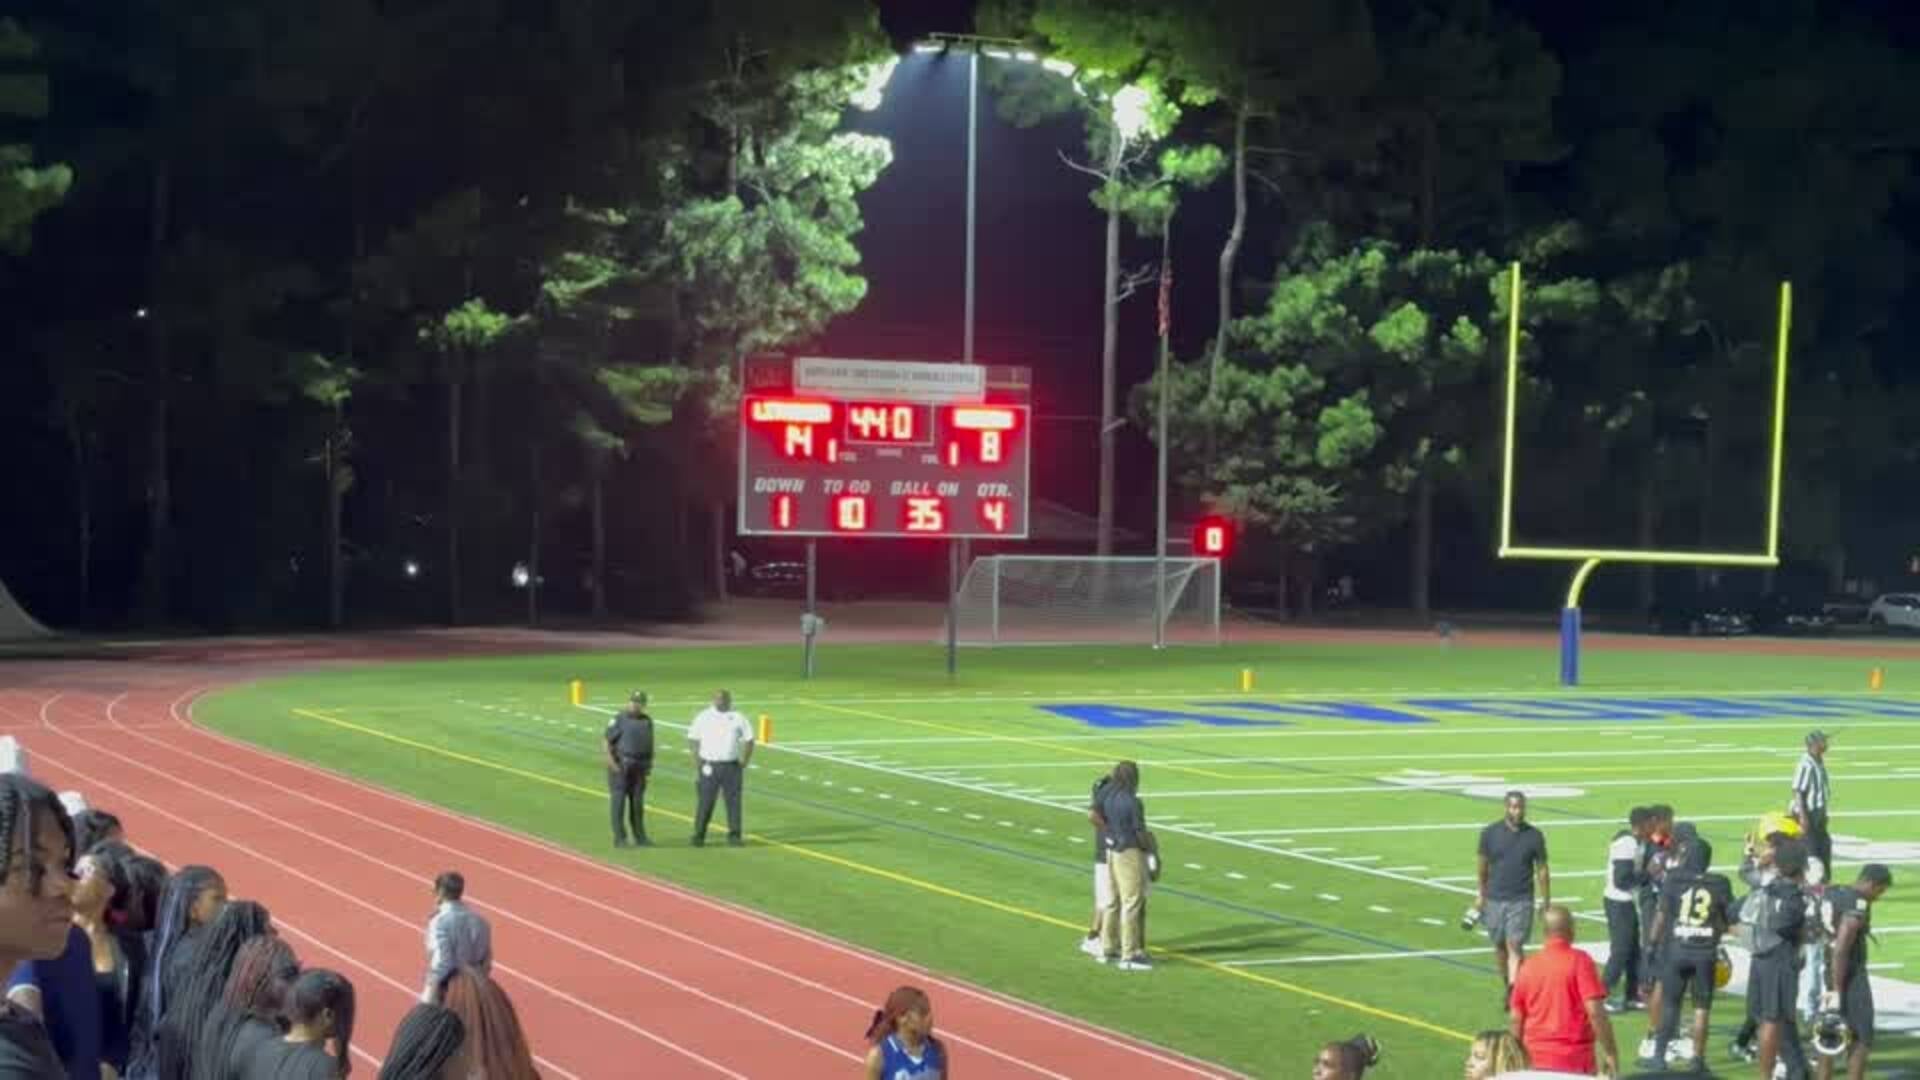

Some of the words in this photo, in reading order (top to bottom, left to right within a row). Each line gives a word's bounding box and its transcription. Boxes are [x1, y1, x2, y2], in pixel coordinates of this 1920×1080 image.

[786, 424, 812, 455] 14
[981, 431, 1000, 462] 8
[754, 477, 804, 493] DOWN
[824, 479, 844, 494] TO
[849, 480, 871, 494] GO
[890, 480, 931, 496] BALL
[937, 482, 960, 496] ON
[780, 496, 789, 528] 1
[838, 497, 864, 529] 10
[907, 498, 942, 531] 35
[983, 501, 1004, 531] 4
[1206, 527, 1222, 551] 0
[1679, 887, 1711, 927] 13
